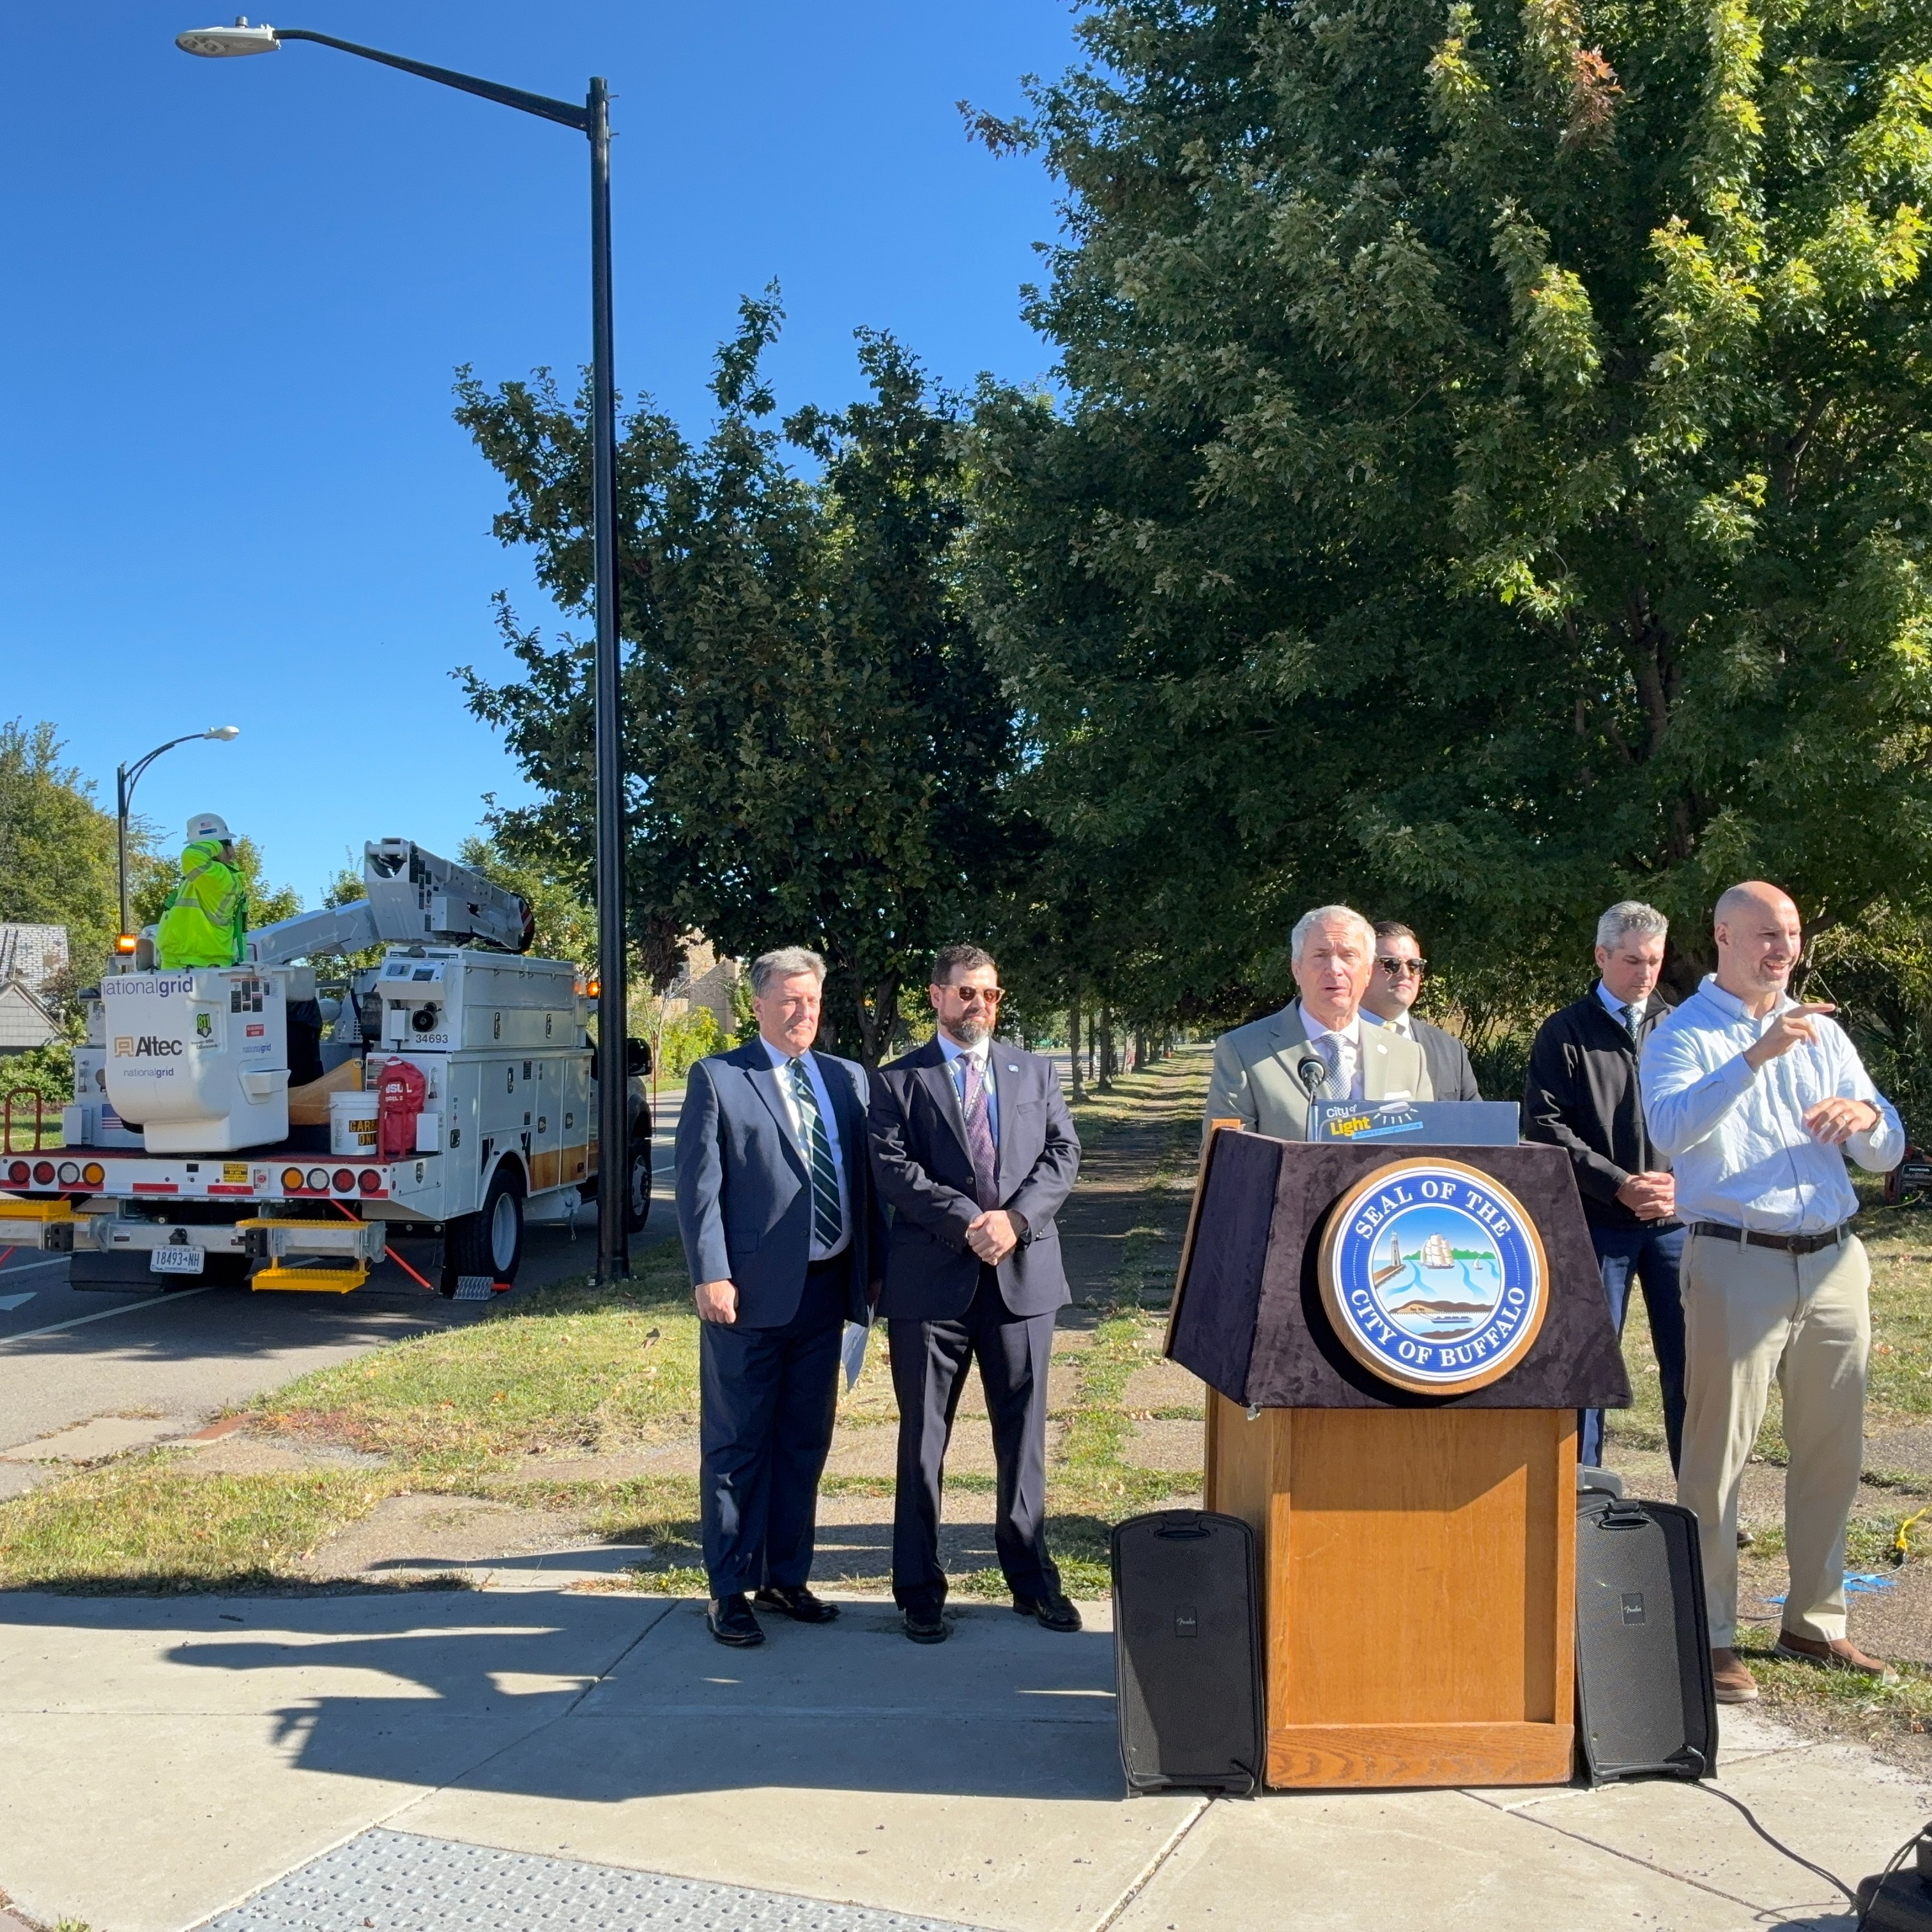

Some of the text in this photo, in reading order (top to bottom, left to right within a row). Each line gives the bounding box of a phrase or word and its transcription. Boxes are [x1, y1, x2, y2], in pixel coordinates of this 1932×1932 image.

[197, 1013, 210, 1029] 811
[135, 1036, 183, 1057] Altec
[415, 1034, 448, 1043] 34693
[123, 1068, 174, 1078] nationalgrid
[1326, 1104, 1358, 1118] City of
[1330, 1116, 1371, 1137] Light
[1355, 1180, 1512, 1239] SEAL OF THE
[1351, 1287, 1526, 1367] CITY OF BUFFALO
